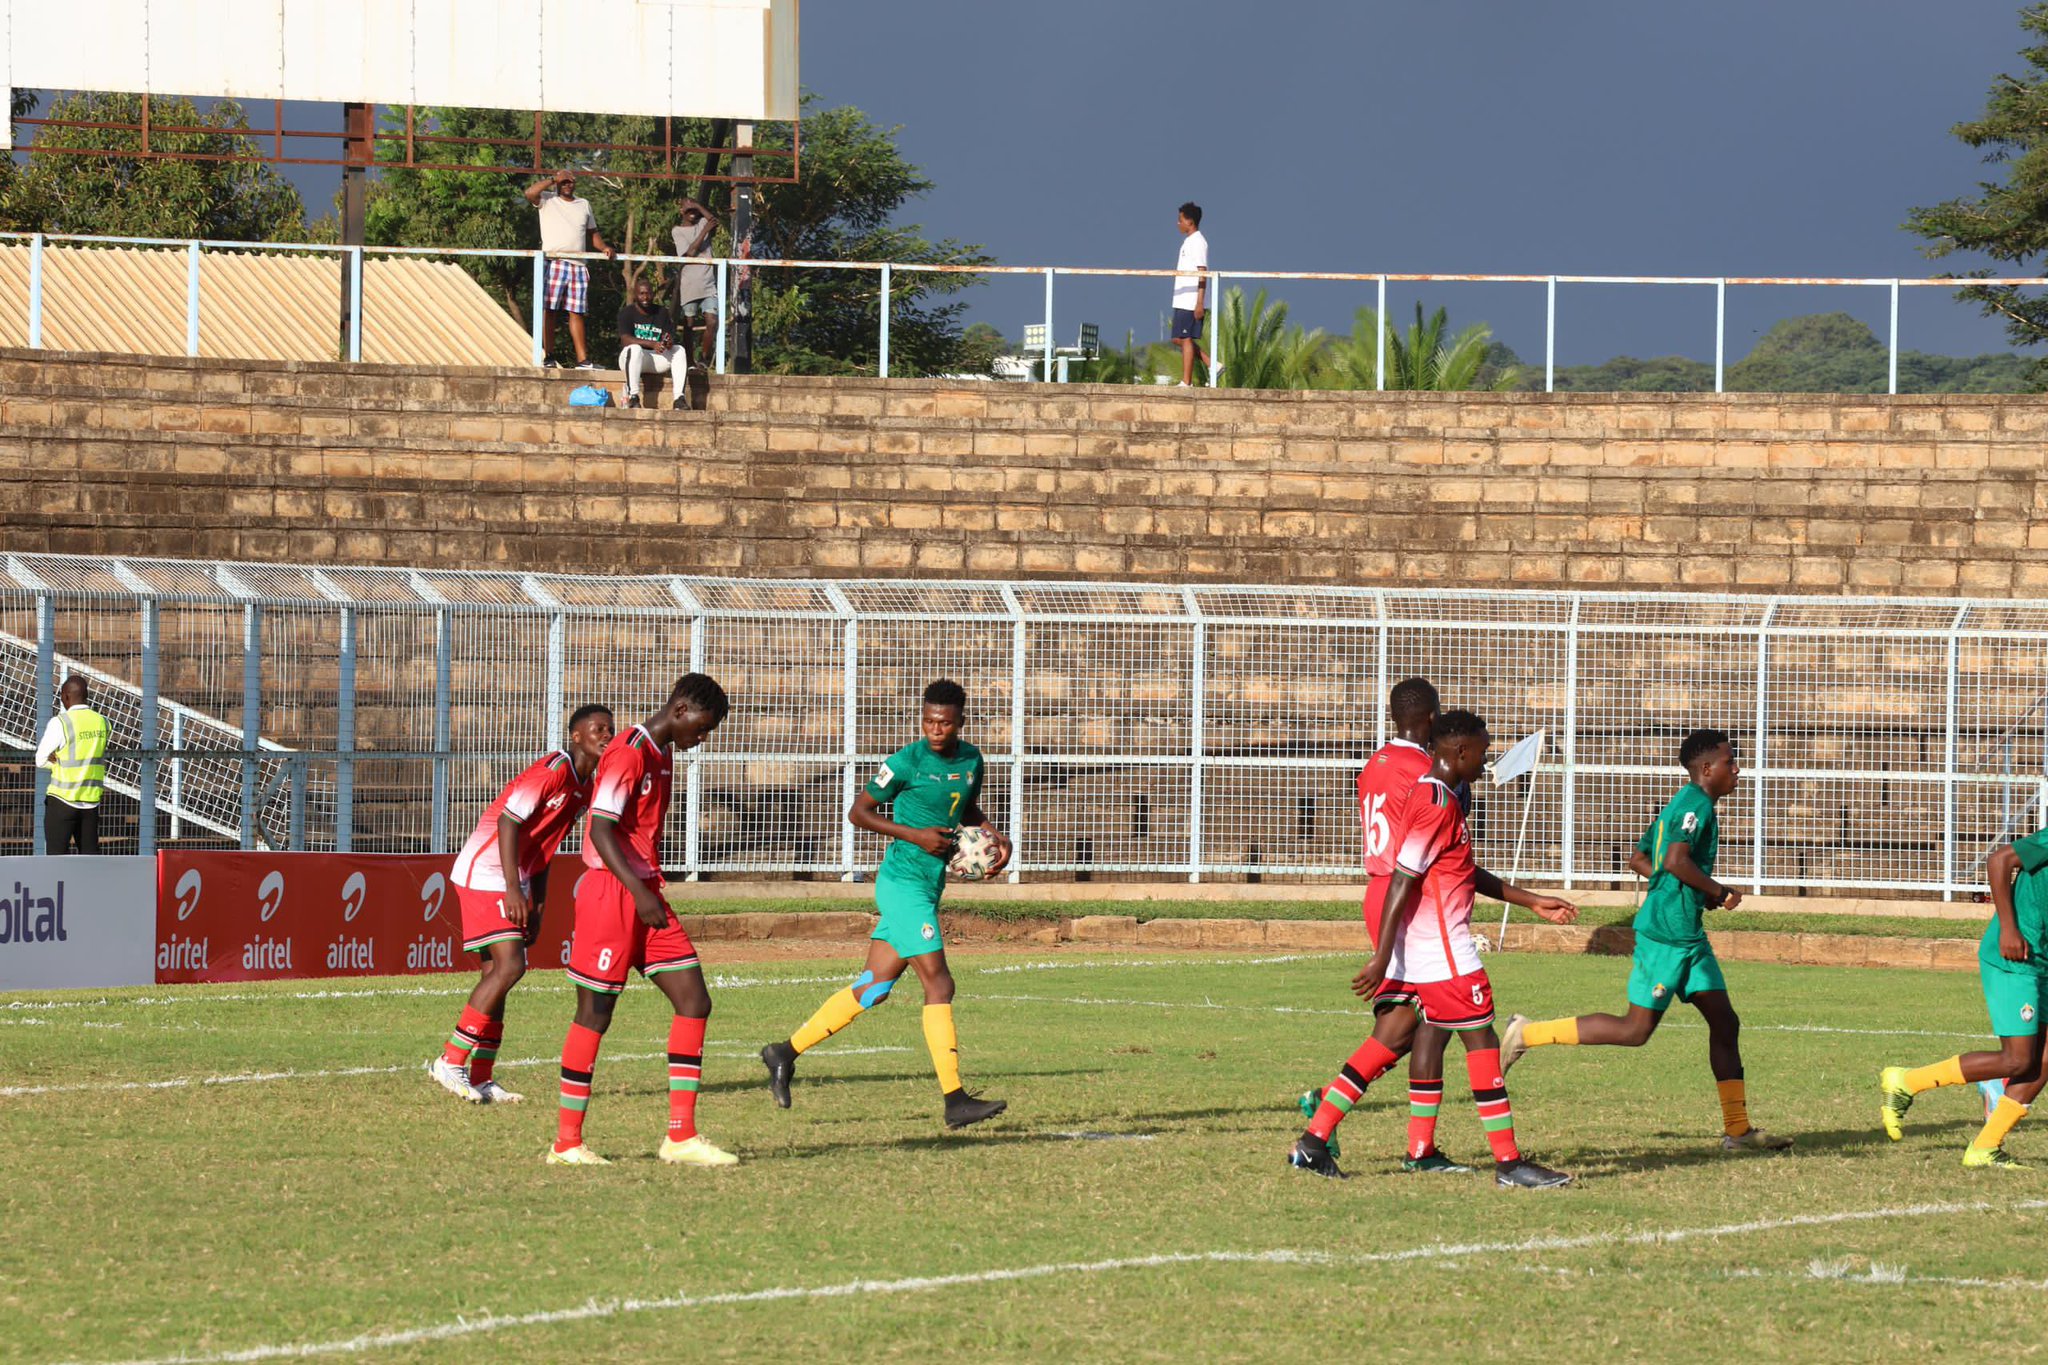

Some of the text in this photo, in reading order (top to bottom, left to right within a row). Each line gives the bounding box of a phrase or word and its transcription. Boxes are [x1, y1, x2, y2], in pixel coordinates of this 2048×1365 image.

[641, 772, 652, 795] 6
[950, 792, 961, 817] 7
[1363, 792, 1390, 857] 15
[496, 899, 507, 919] 1
[157, 933, 209, 970] airtel
[242, 934, 293, 970] airtel
[327, 934, 375, 970] airtel
[407, 934, 454, 969] airtel
[597, 947, 613, 972] 6
[1471, 983, 1484, 1006] 5
